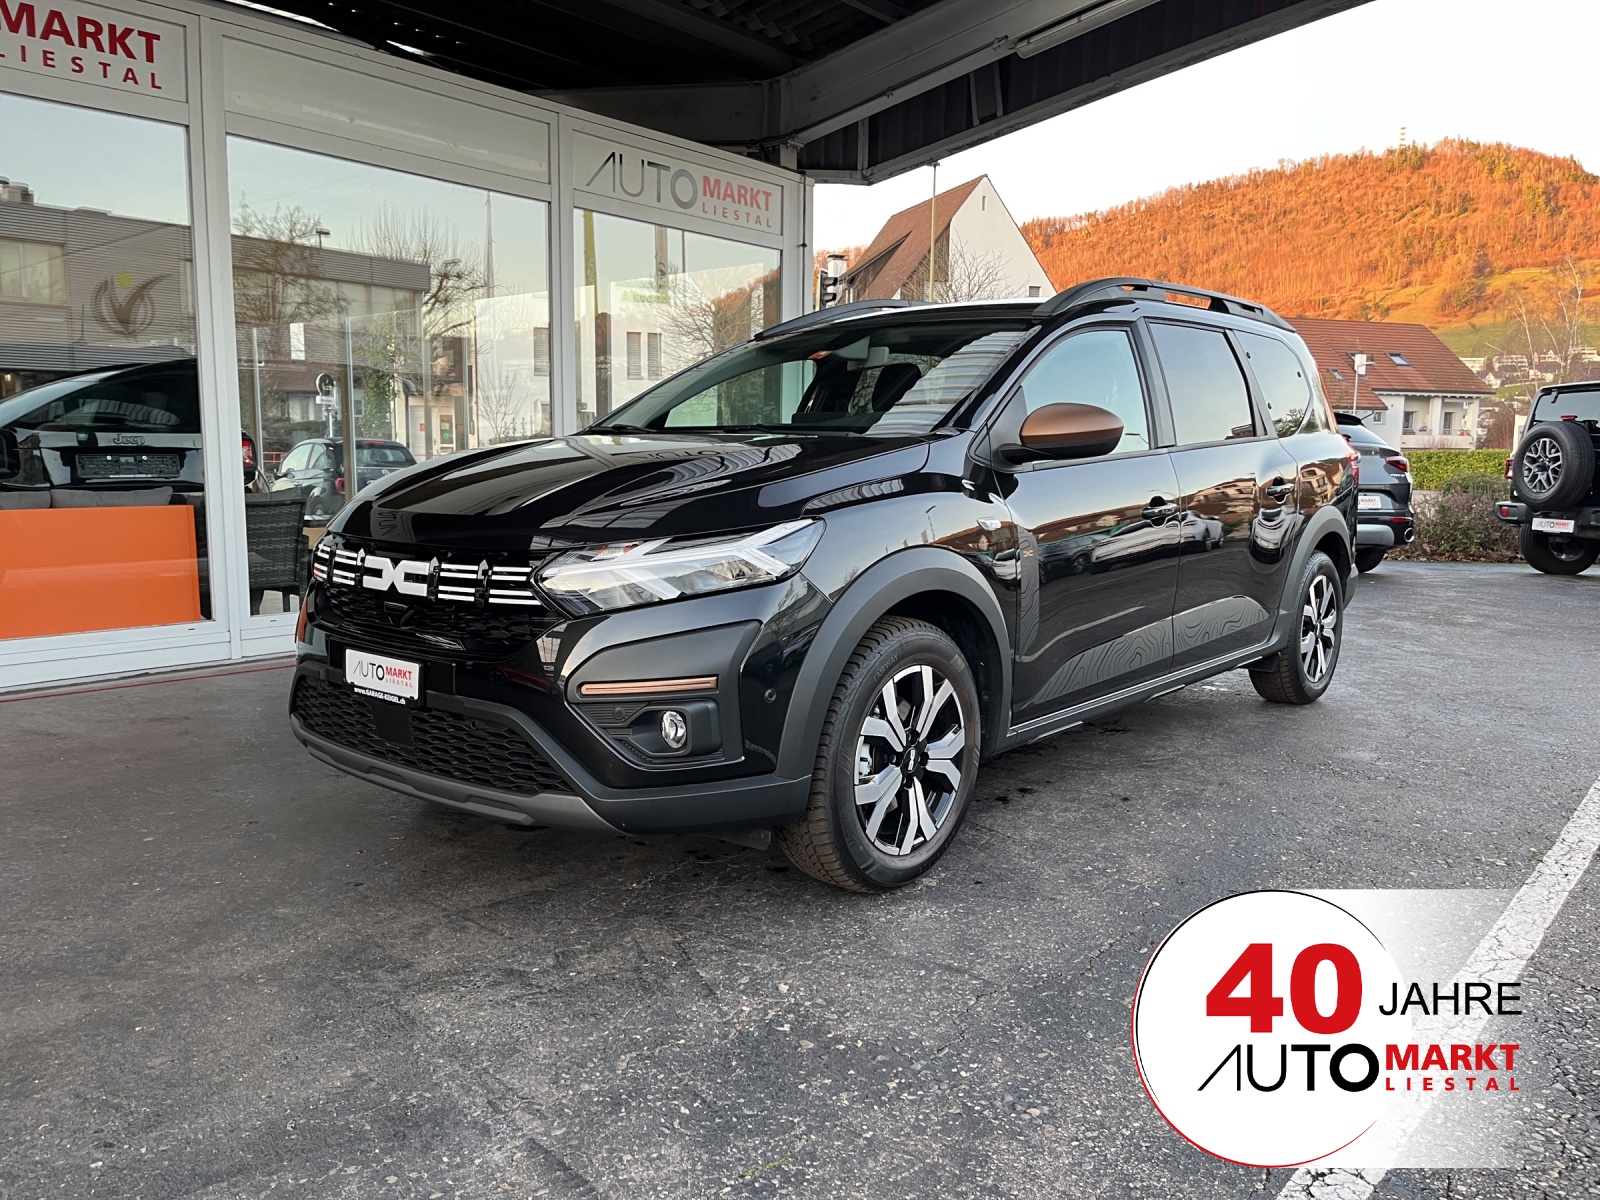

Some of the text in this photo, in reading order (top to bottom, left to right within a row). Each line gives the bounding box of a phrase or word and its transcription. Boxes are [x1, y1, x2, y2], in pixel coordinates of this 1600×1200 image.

[0, 0, 161, 64] MARKT
[0, 45, 162, 90] IESTAL
[702, 175, 773, 211] MARKT
[702, 202, 772, 228] LIESTAL
[113, 433, 145, 446] Jeep
[873, 653, 898, 682] FAIRWAY
[386, 678, 412, 688] LIESTAL
